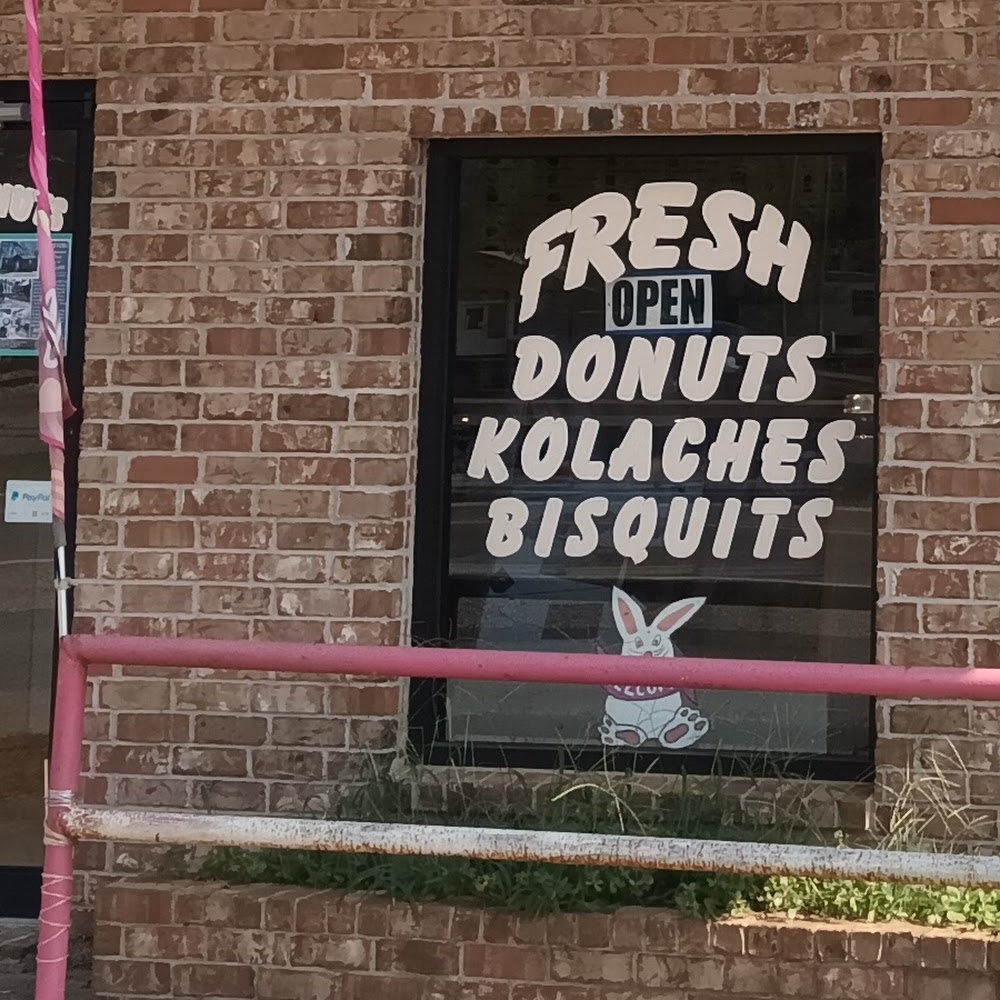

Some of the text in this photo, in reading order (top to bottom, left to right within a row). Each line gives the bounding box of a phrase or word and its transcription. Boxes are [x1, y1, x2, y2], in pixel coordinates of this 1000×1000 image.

[518, 181, 812, 324] FRESH
[612, 277, 705, 328] OPEN
[512, 335, 827, 402] DONUTS
[466, 417, 856, 484] KOLACHES
[486, 496, 834, 564] BISQUITS
